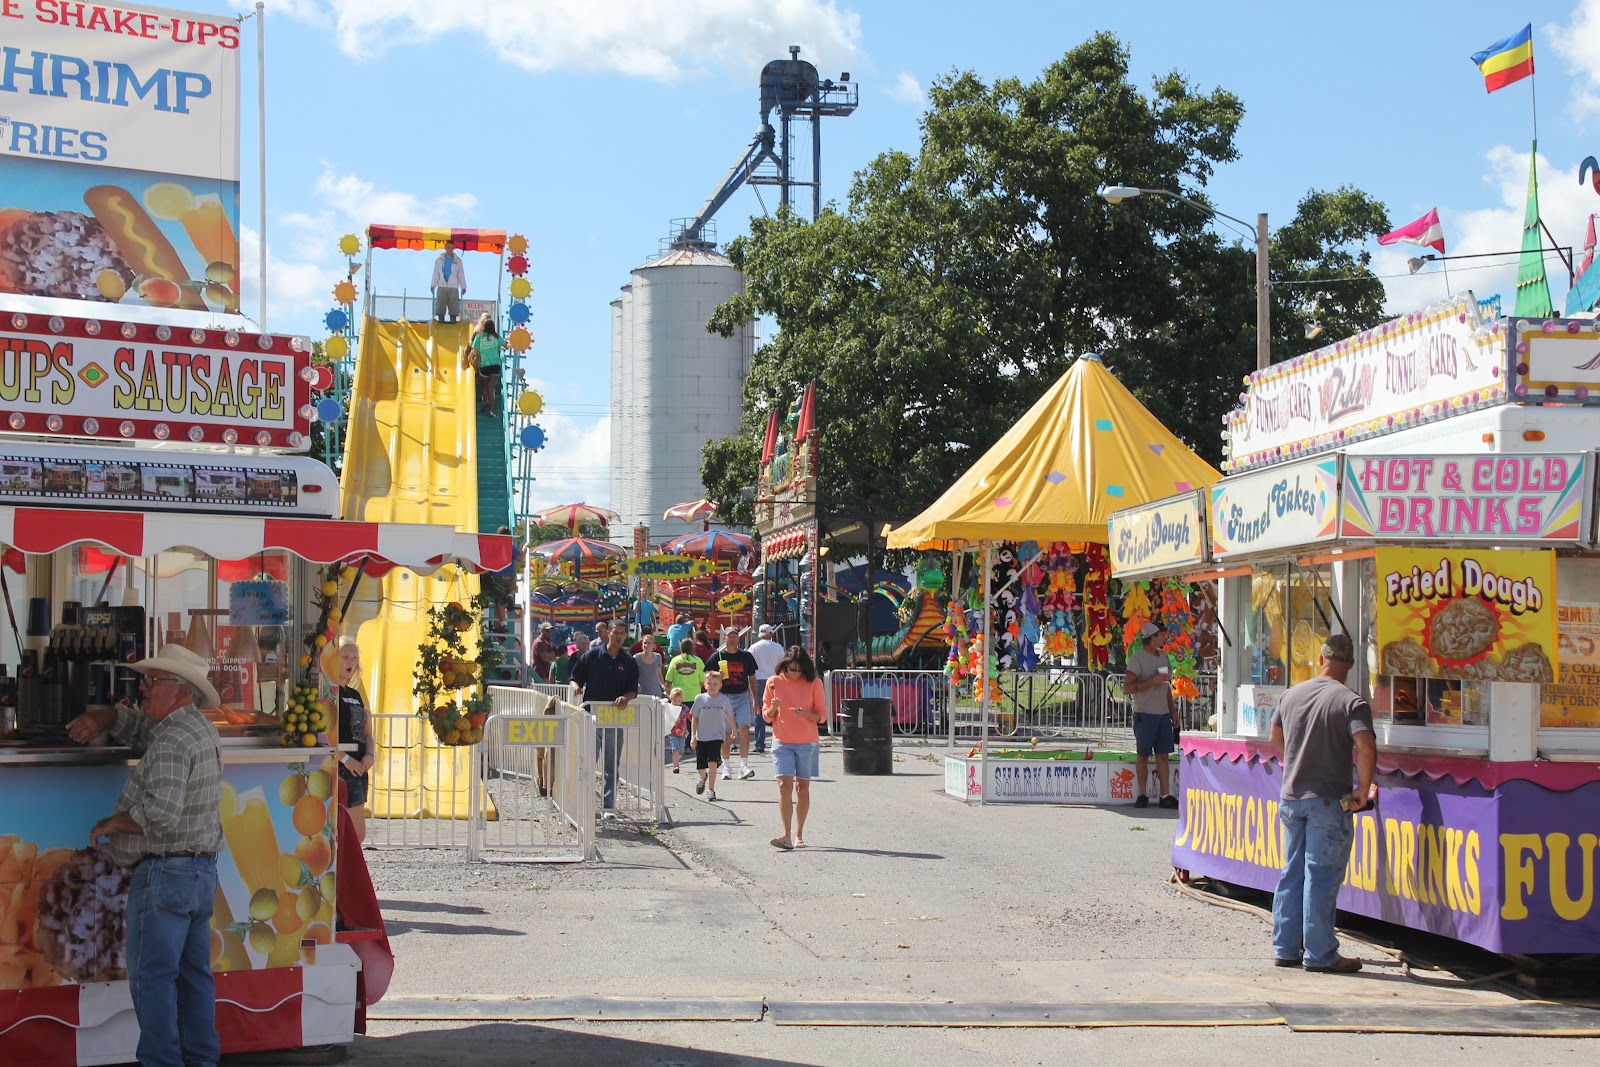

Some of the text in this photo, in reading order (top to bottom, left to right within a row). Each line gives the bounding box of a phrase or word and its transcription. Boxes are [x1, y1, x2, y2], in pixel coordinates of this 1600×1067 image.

[35, 0, 240, 49] SHAKE-UPS
[0, 47, 212, 114] HRIMP
[0, 336, 286, 421] UPS SAUSAGE
[1256, 394, 1280, 434] FUNNEL
[1289, 382, 1312, 422] CAKES
[1385, 349, 1417, 396] FUNNEL
[1429, 333, 1458, 380] CAKES
[1359, 456, 1569, 493] HOT & COLD
[1227, 474, 1316, 544] Funnel Cakes
[1376, 495, 1546, 537] DRINKS
[1118, 512, 1190, 565] Fried Dough
[638, 560, 692, 576] TEMPEST
[1385, 558, 1543, 616] Fried Dough
[87, 612, 112, 625] PEPSI
[1572, 663, 1600, 674] COL
[508, 705, 636, 743] EXIT ENTER
[1569, 696, 1600, 707] DRIN
[995, 766, 1043, 798] SHARK
[1044, 766, 1099, 798] ATTACK
[1244, 795, 1287, 870] CAK
[1342, 813, 1377, 892] LD
[1385, 818, 1481, 915] DRINKS
[1499, 832, 1600, 921] FU
